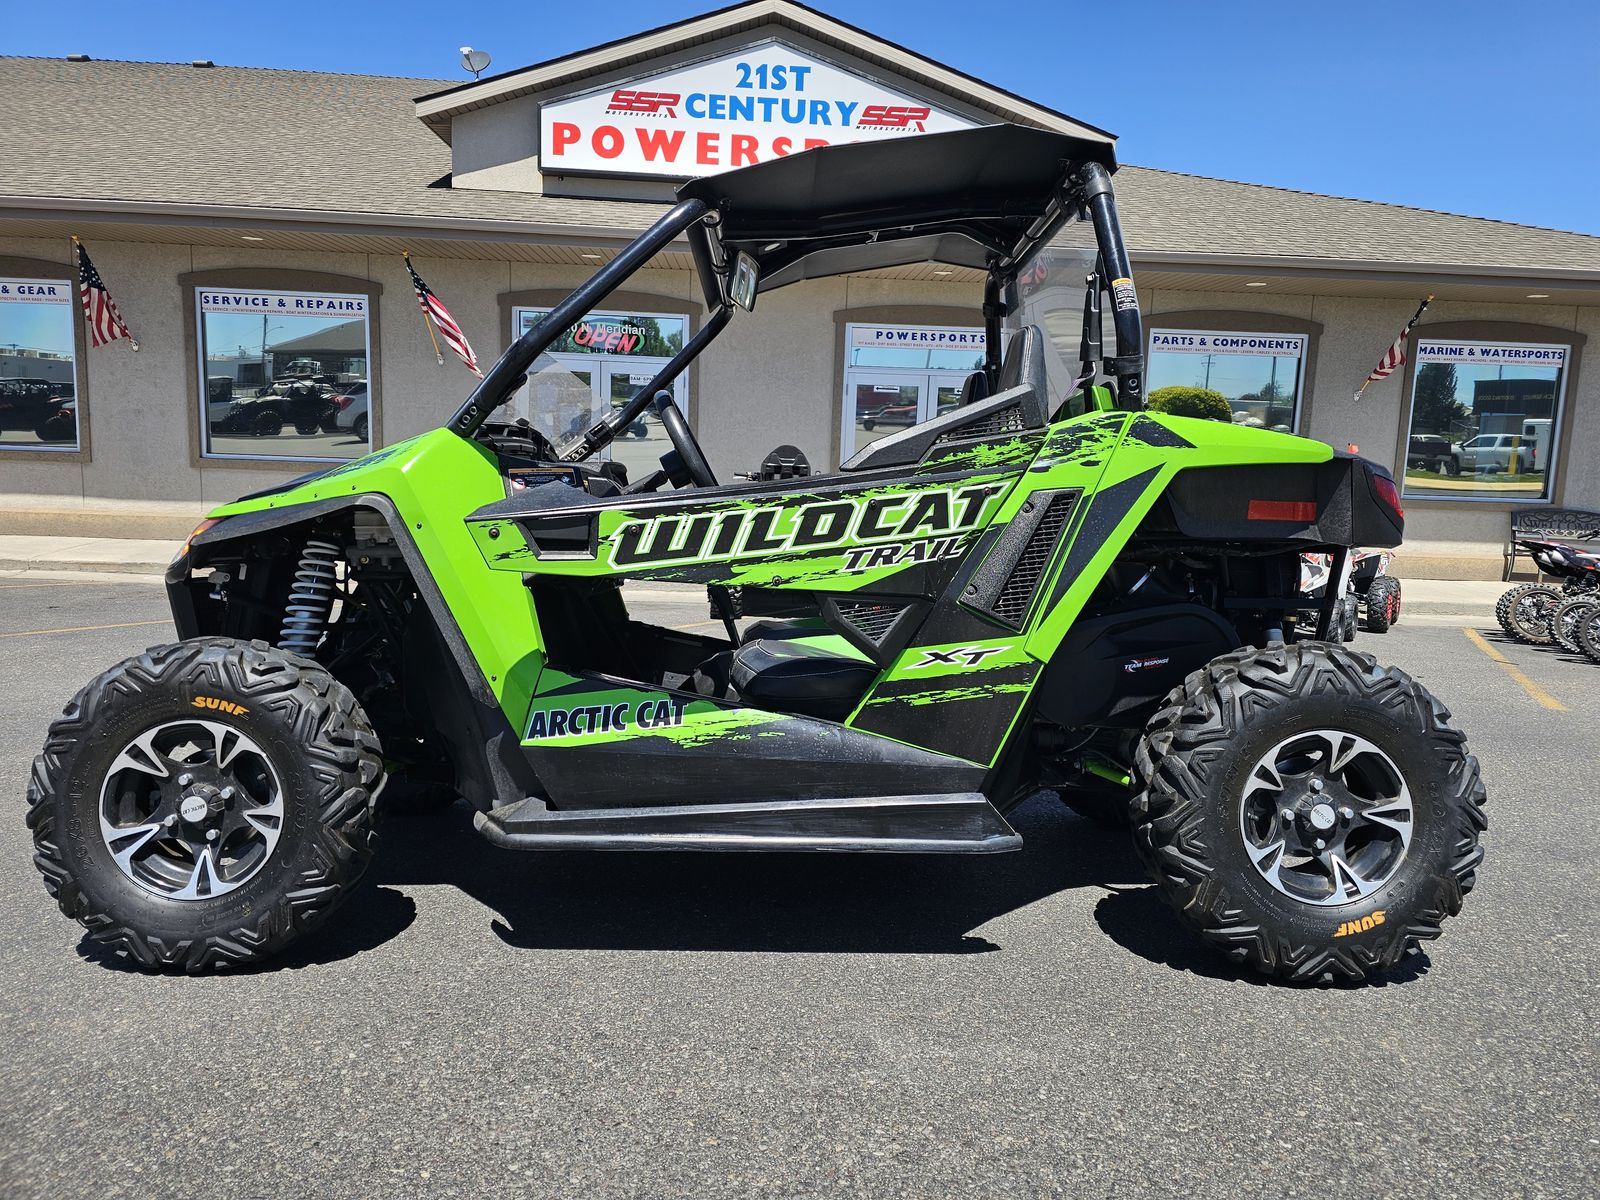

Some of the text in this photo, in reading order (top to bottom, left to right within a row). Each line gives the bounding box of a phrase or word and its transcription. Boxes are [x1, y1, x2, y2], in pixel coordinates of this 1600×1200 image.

[736, 62, 811, 91] 21ST
[605, 110, 668, 118] MOTORSPORTS
[607, 90, 681, 118] SSR
[685, 93, 858, 126] CENTURY
[858, 105, 931, 132] SSR
[553, 121, 858, 166] POWERS
[17, 286, 56, 296] GEAR
[203, 295, 363, 311] SERVICE & REPAIRS
[574, 324, 637, 352] OPEN
[875, 330, 986, 343] POWERSPORTS
[1153, 336, 1299, 350] PARTS & COMPONENTS
[1418, 346, 1563, 360] MARINE & WATERSPORTS
[608, 481, 1013, 570] WILDCAT
[840, 535, 970, 573] TRAIL
[902, 644, 1015, 670] XT
[191, 696, 250, 716] SUNF
[525, 699, 691, 741] ARCTIC CAT
[1334, 910, 1387, 937] SUNF
